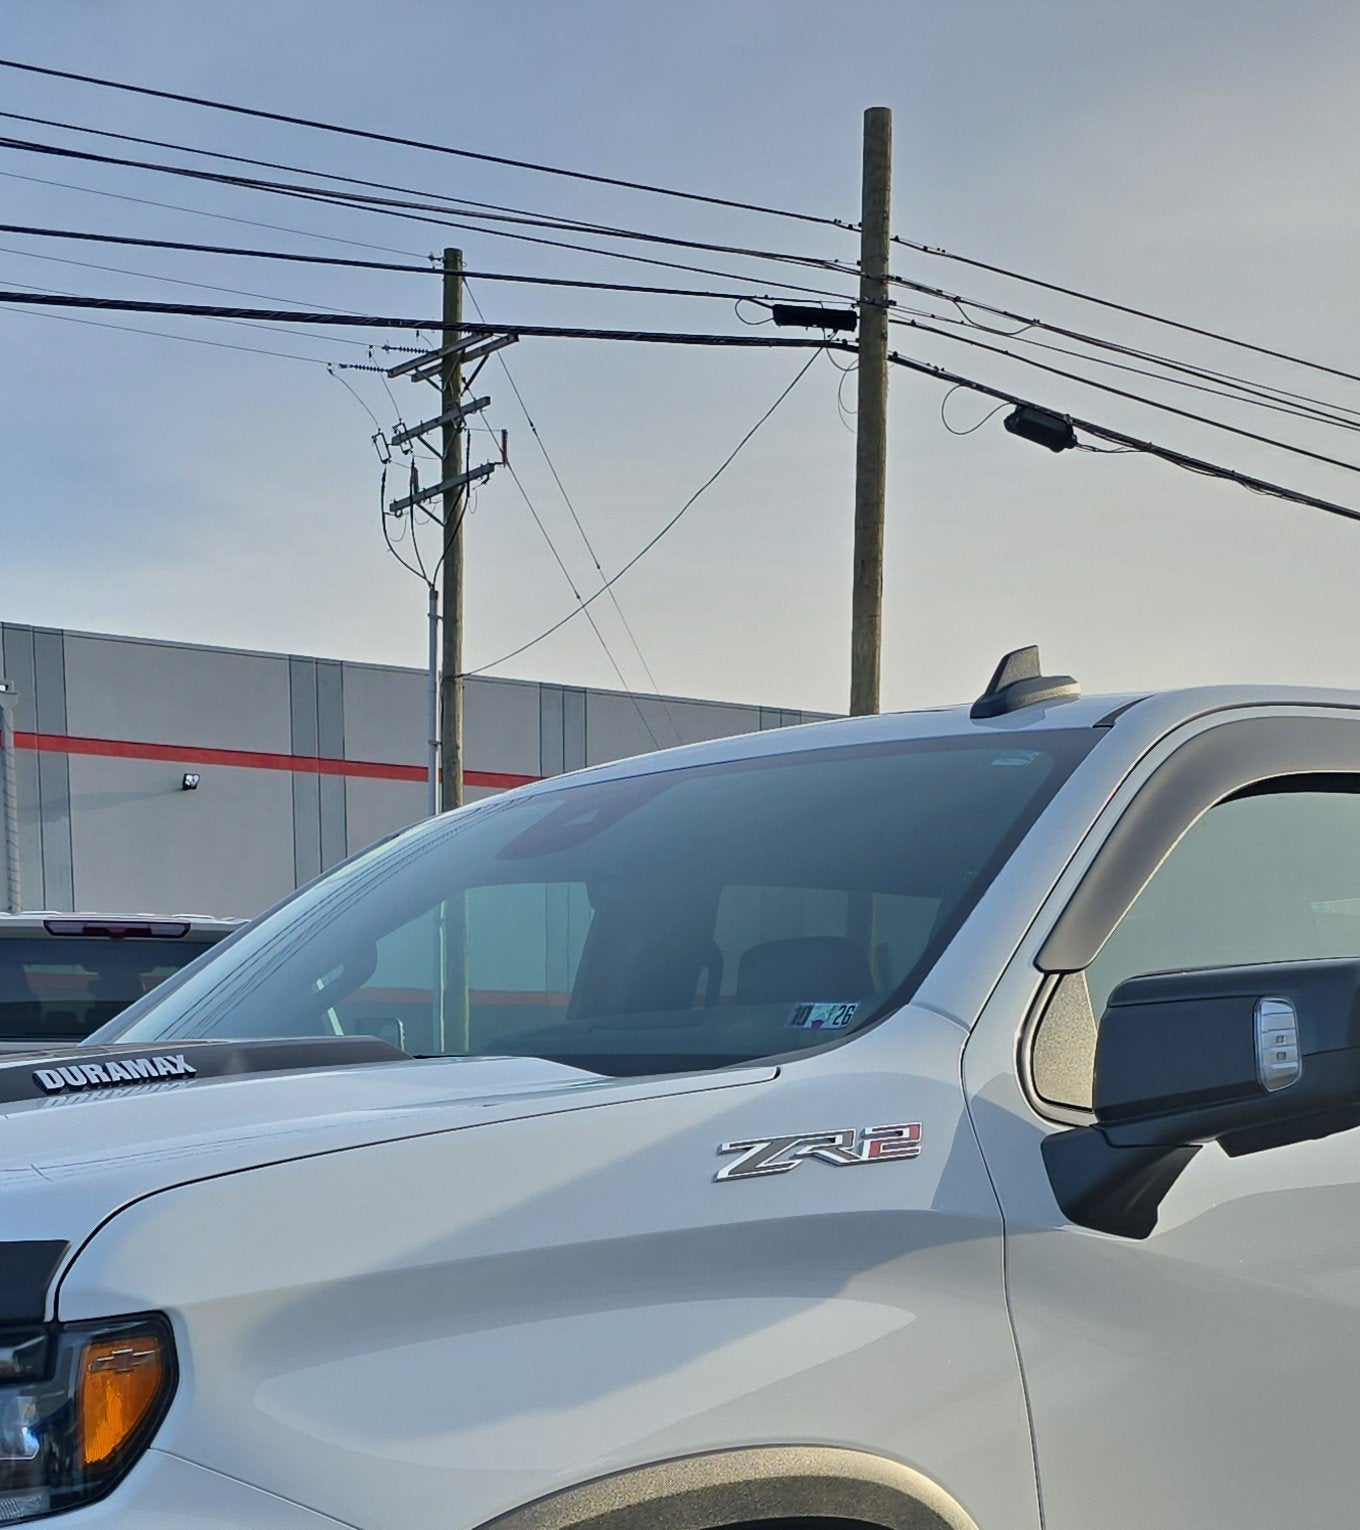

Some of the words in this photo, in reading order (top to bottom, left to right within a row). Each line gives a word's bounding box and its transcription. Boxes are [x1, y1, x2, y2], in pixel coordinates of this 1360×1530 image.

[832, 1005, 855, 1026] 26
[33, 1054, 197, 1094] DURAMAX
[711, 1121, 923, 1183] ZR2
